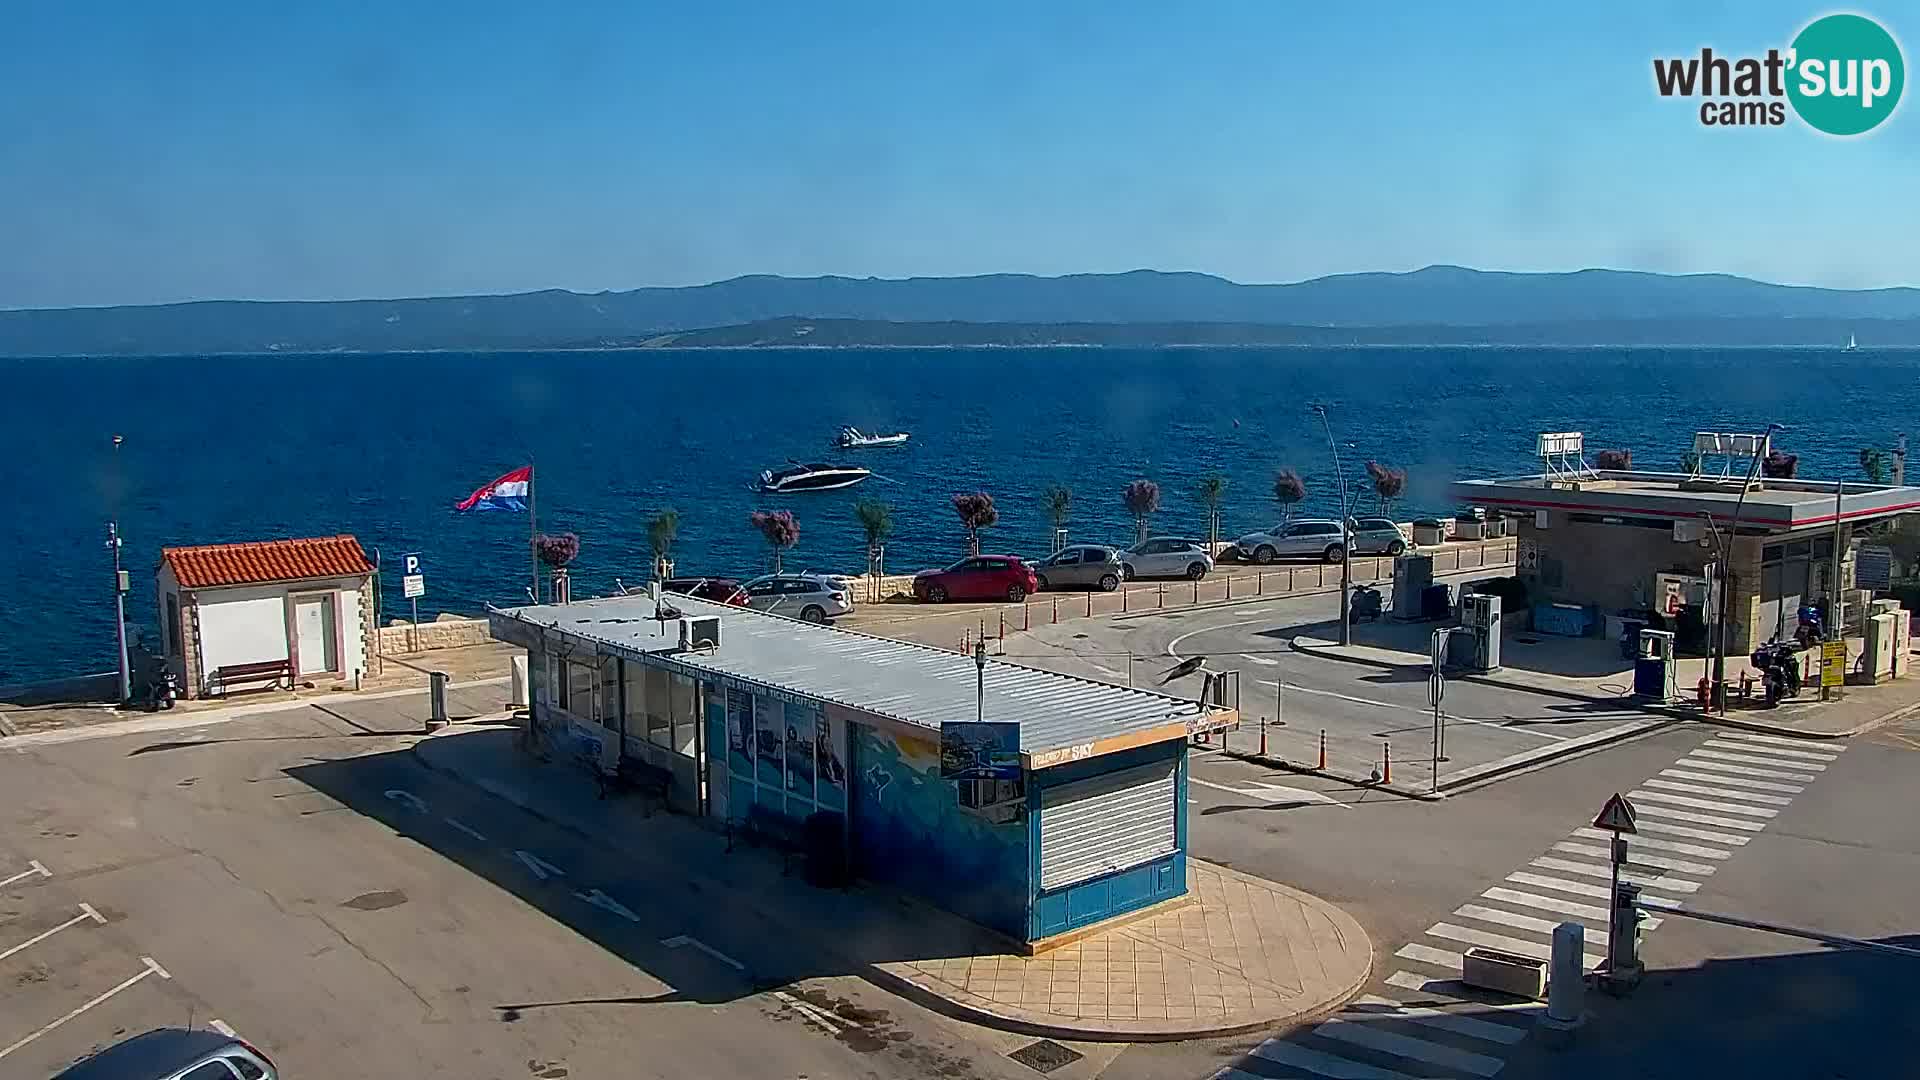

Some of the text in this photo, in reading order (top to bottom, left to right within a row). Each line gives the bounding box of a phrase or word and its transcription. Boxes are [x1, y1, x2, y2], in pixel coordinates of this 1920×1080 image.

[407, 556, 419, 574] P
[737, 681, 767, 697] STATION
[769, 687, 793, 703] TICKET
[795, 696, 821, 711] OFFICE
